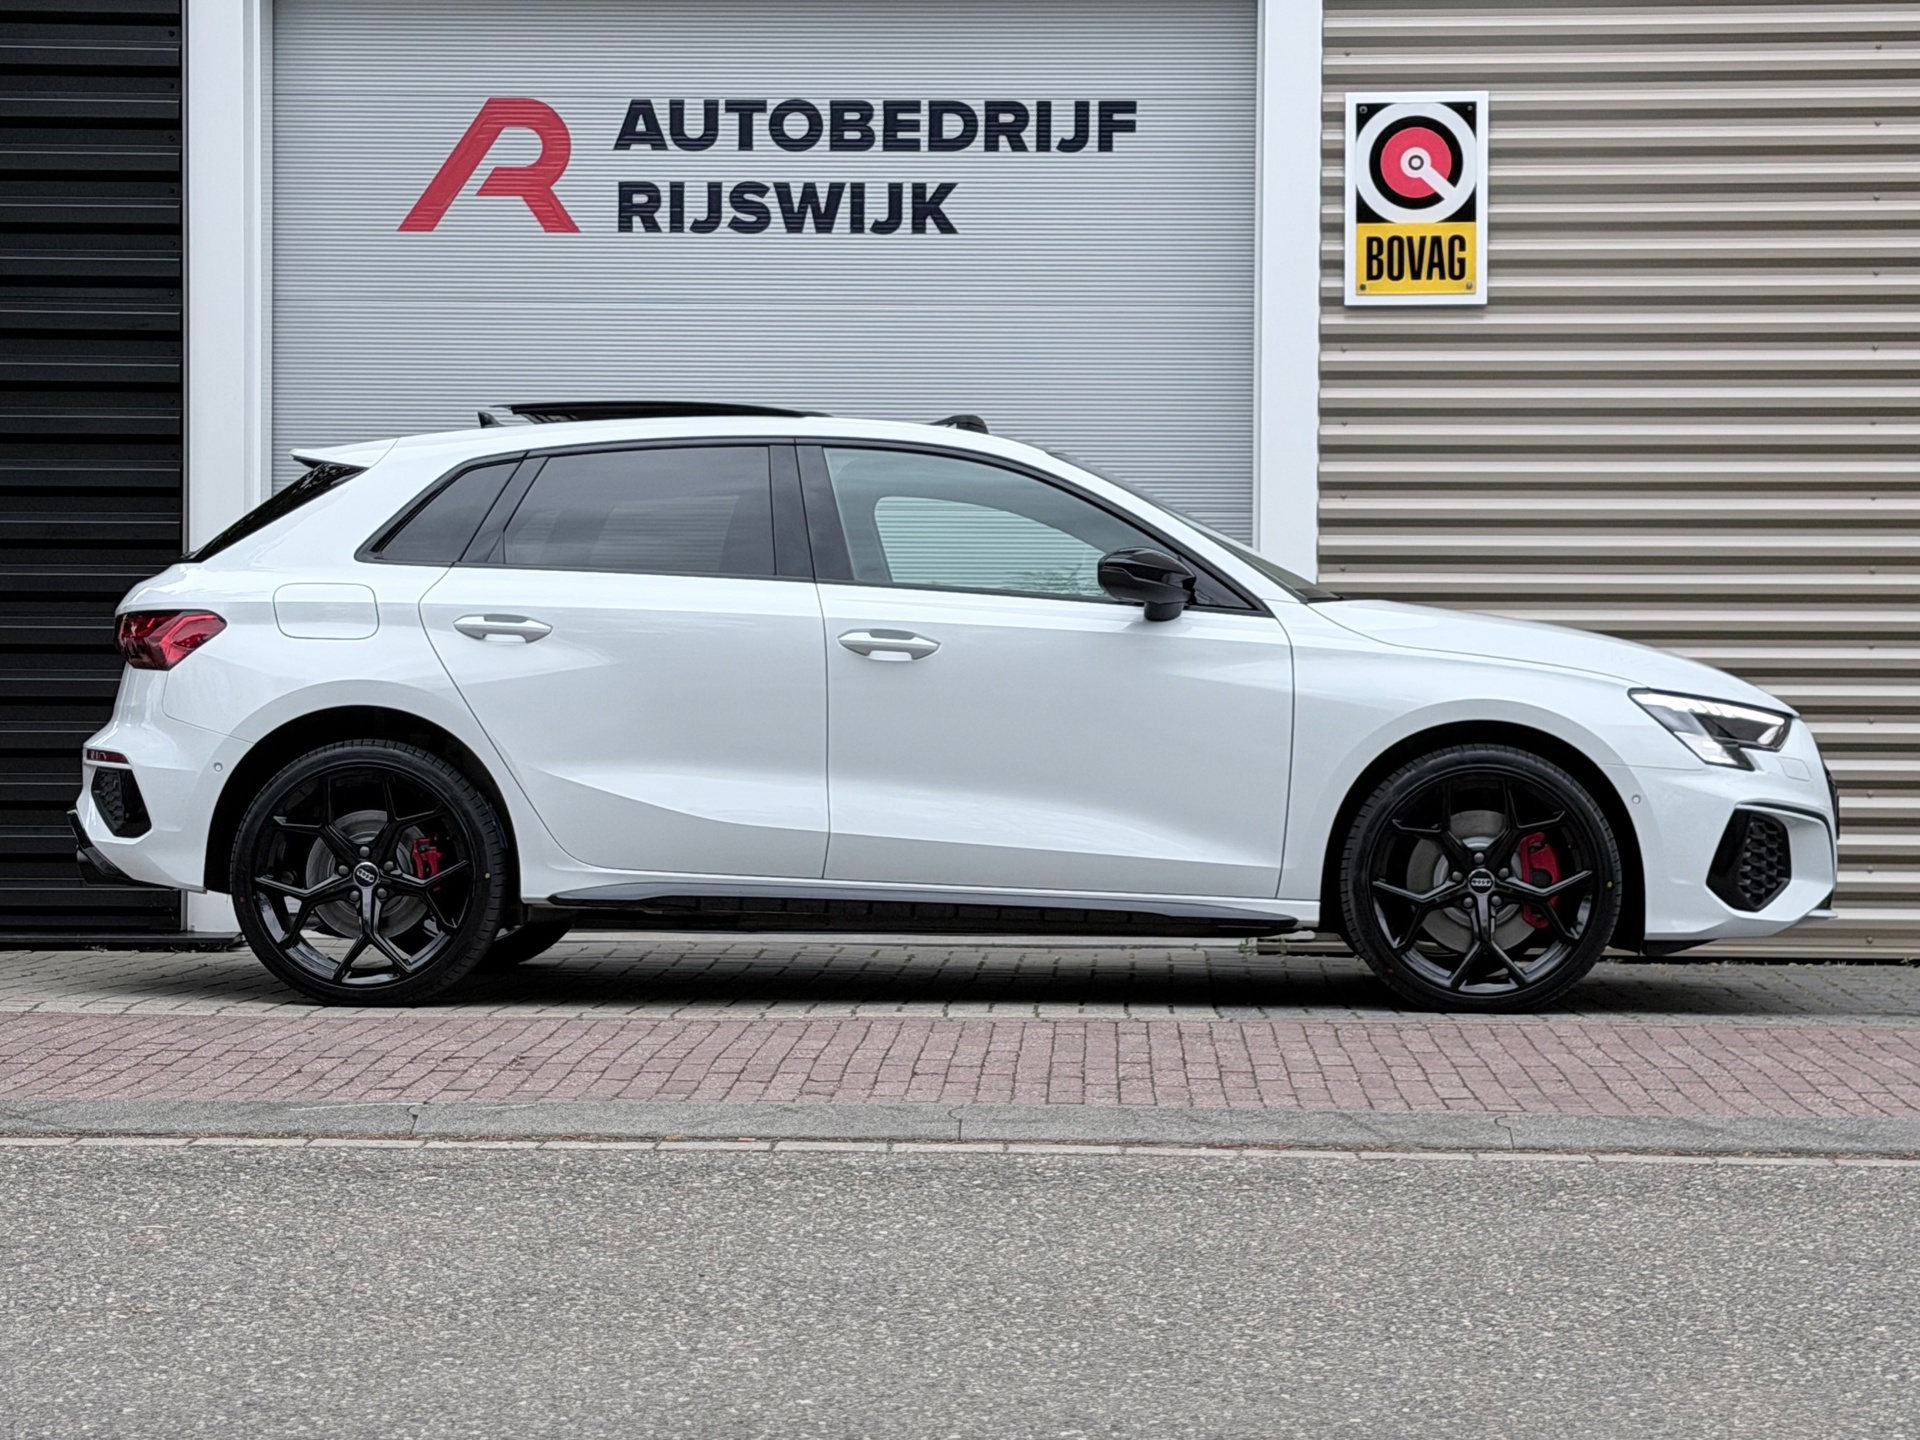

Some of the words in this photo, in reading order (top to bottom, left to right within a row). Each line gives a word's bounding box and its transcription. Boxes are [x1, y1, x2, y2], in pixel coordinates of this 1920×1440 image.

[613, 98, 1138, 153] AUTOBEDRIJF
[617, 181, 959, 235] RIJSWIJK
[1365, 234, 1466, 282] BOVAG
